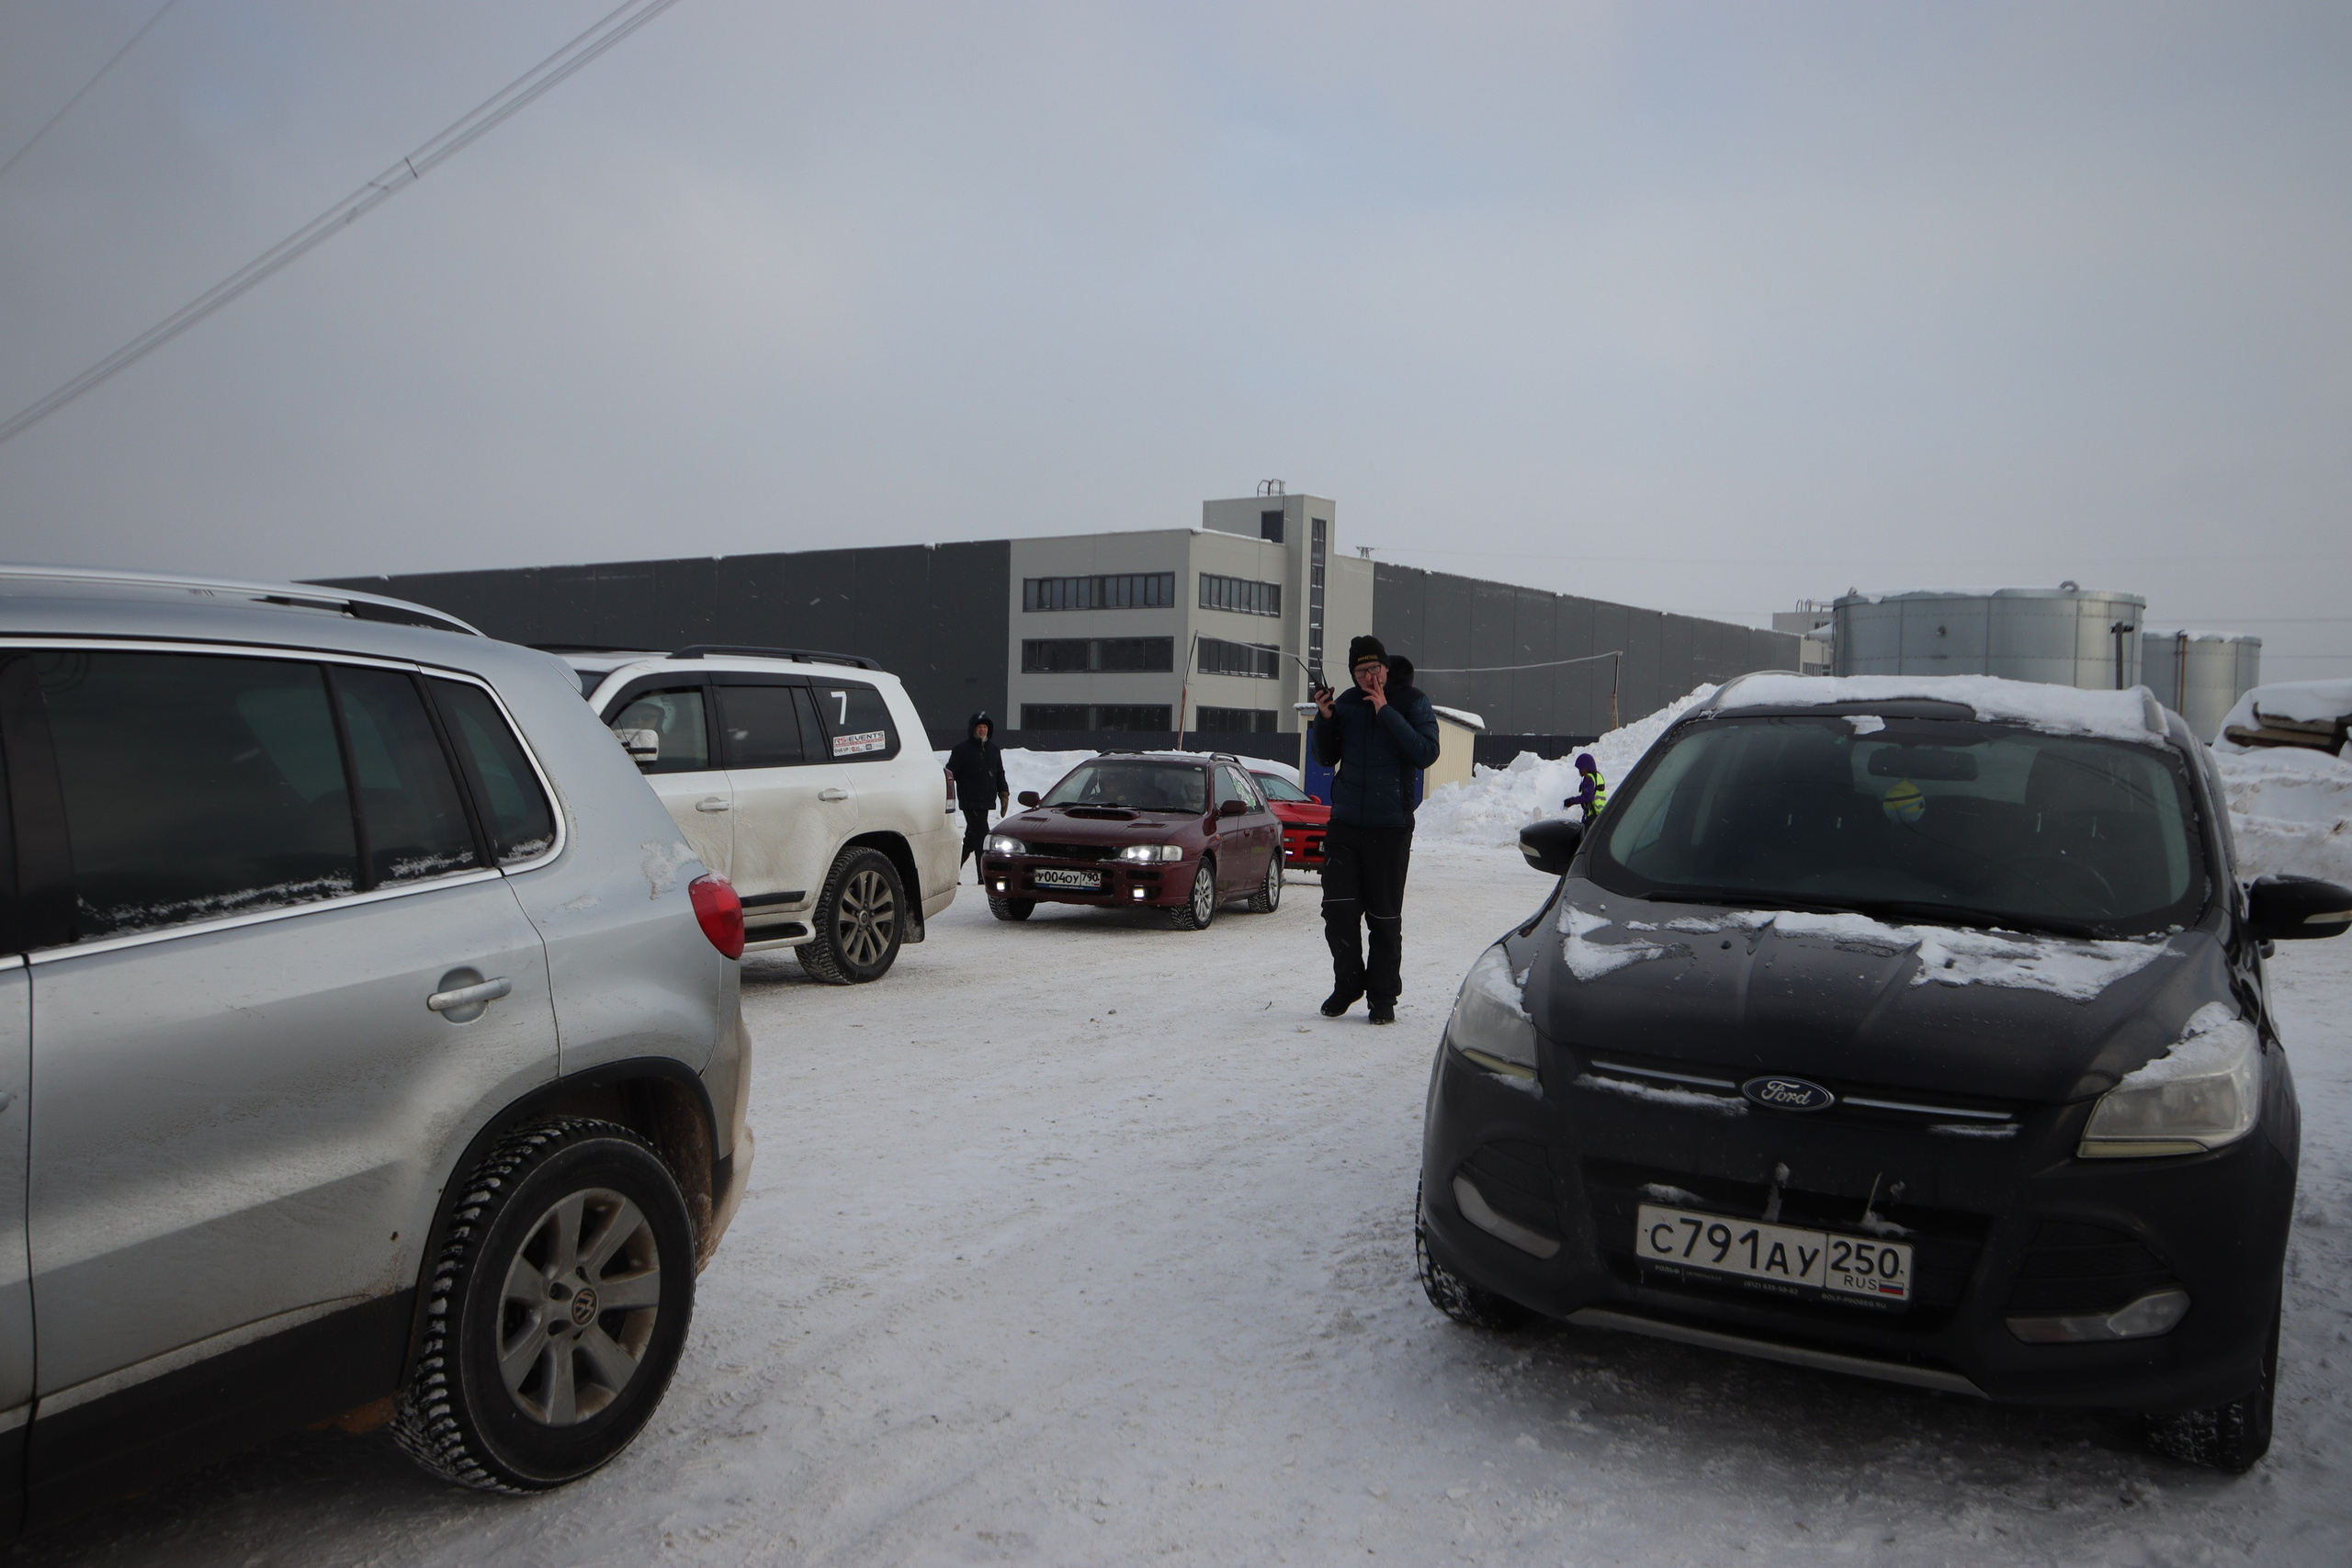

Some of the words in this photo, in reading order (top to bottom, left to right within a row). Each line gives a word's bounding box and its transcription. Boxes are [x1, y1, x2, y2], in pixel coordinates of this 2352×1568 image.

[831, 691, 847, 725] 7
[848, 732, 884, 742] EVENTS
[1081, 873, 1098, 882] 790
[1761, 1080, 1812, 1105] Ford
[1830, 1240, 1900, 1279] 250
[1655, 1264, 1680, 1275] РОЛЬФ
[1843, 1273, 1878, 1292] RUS
